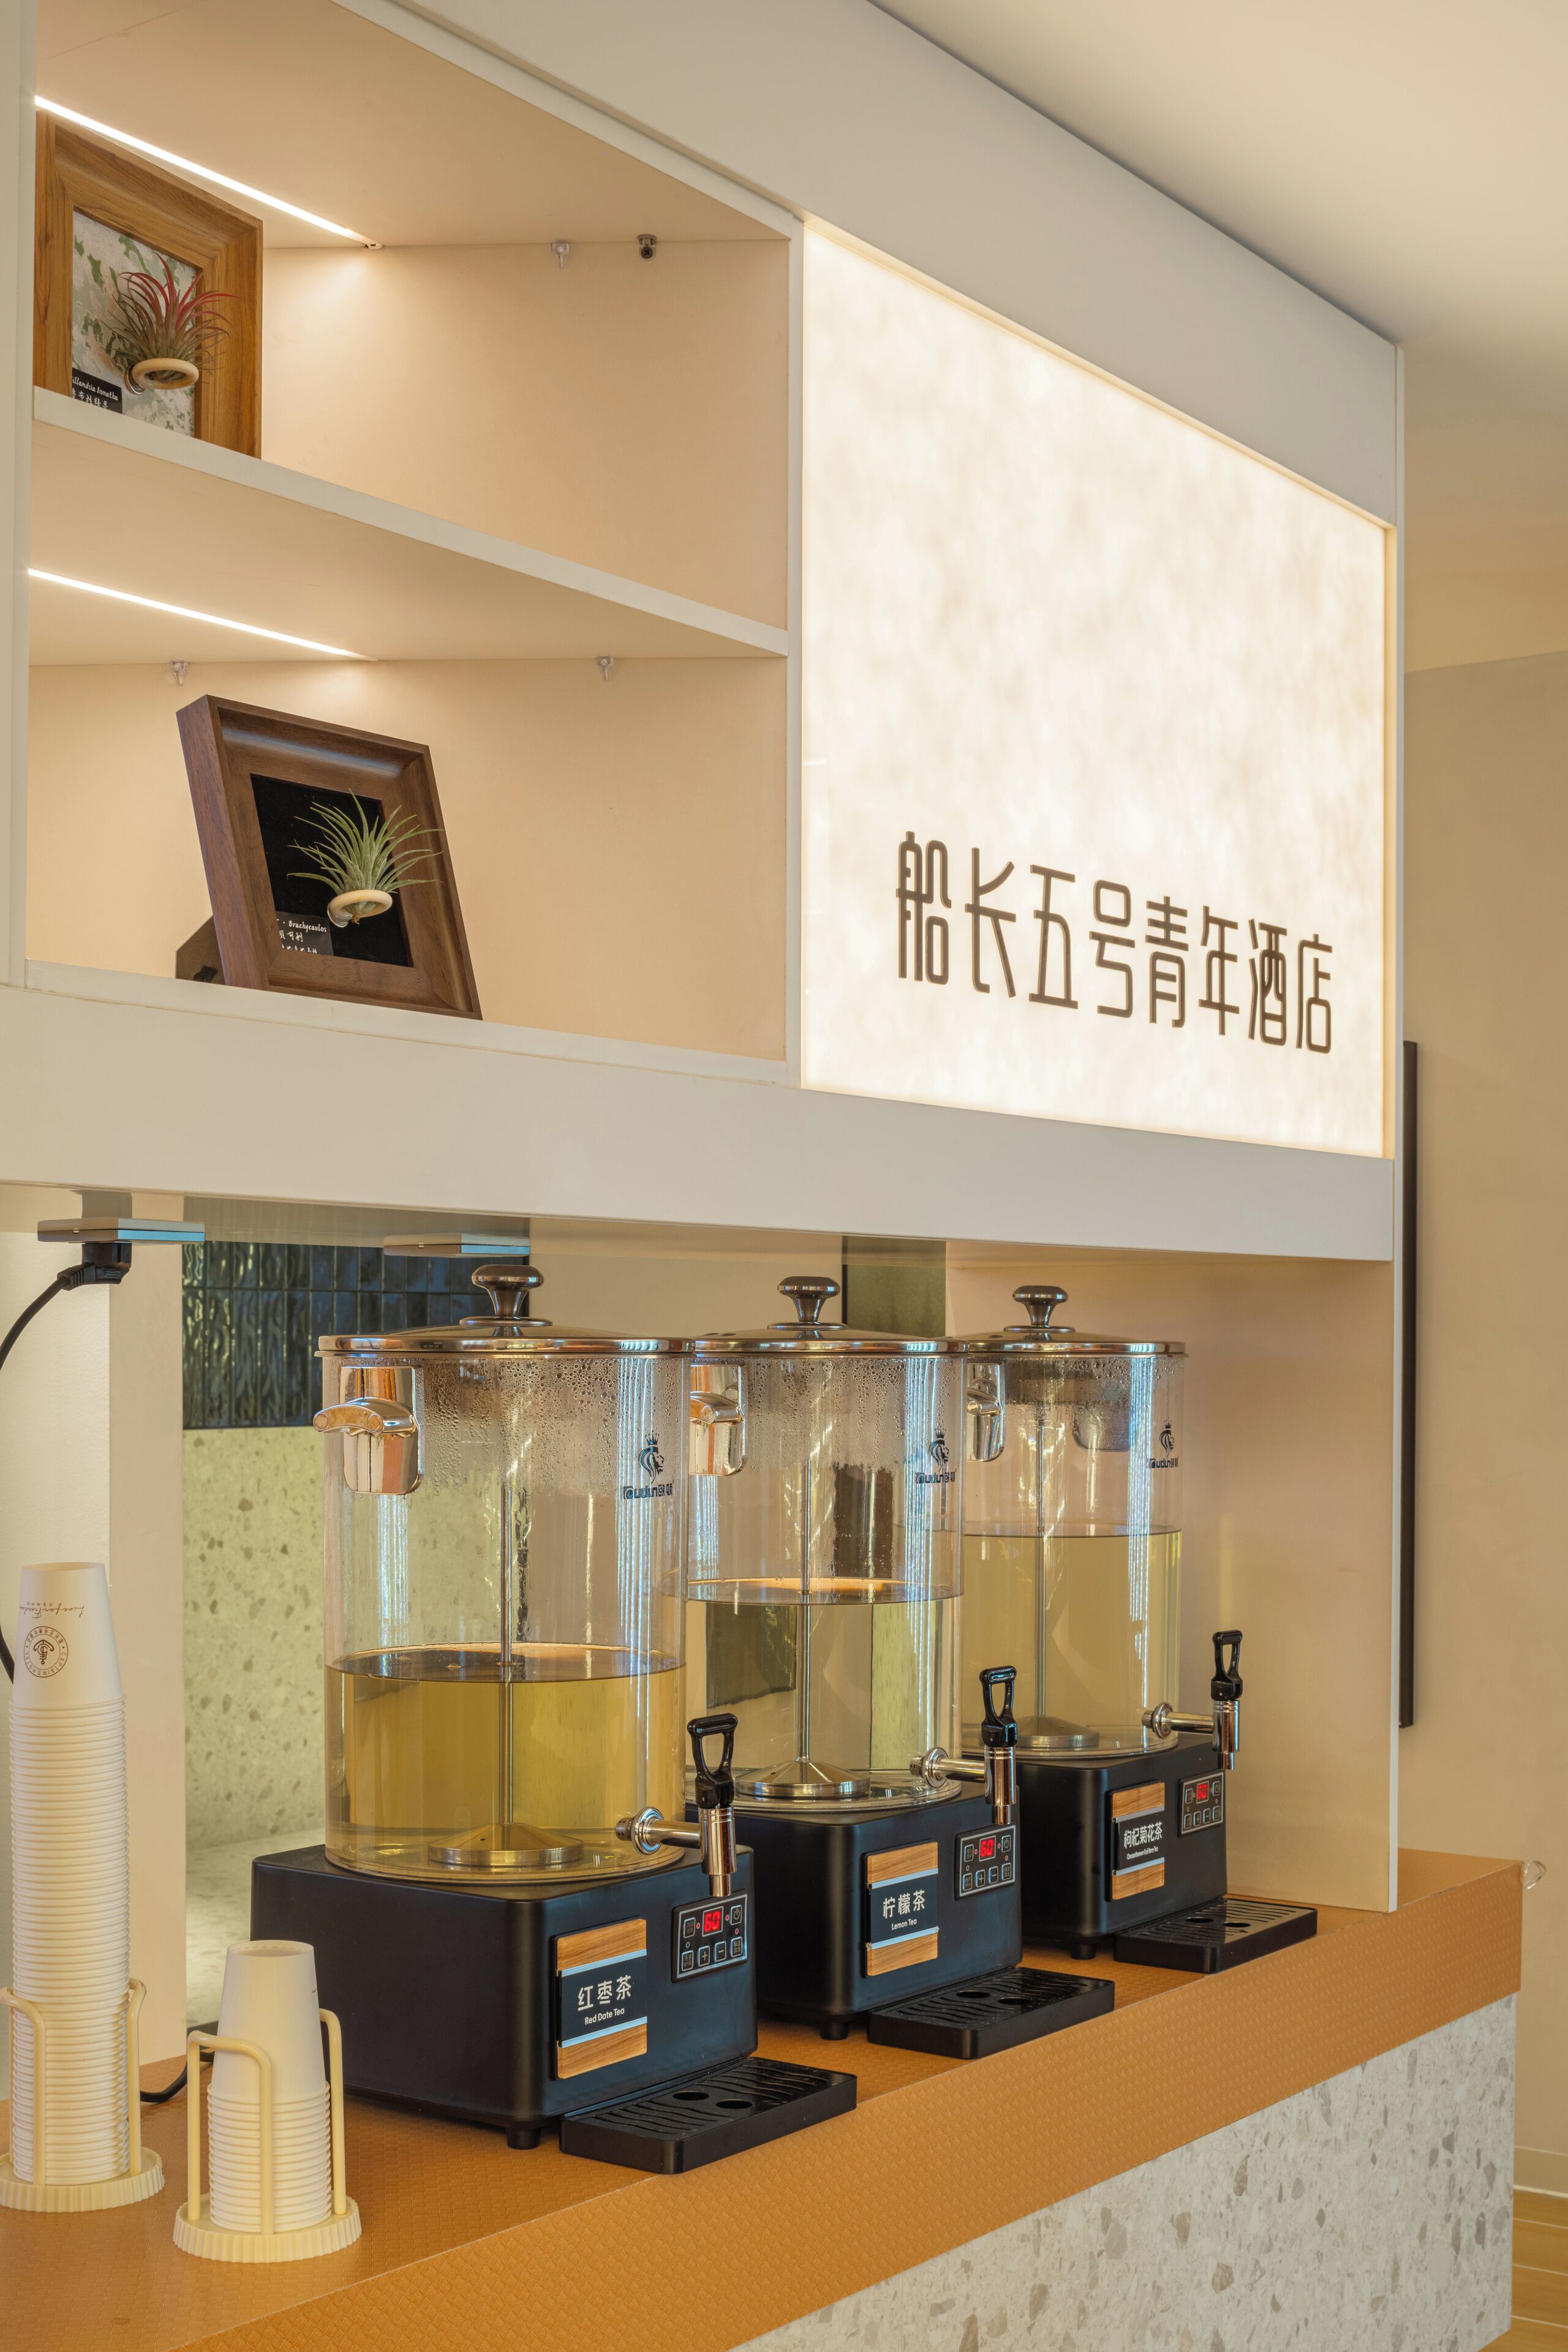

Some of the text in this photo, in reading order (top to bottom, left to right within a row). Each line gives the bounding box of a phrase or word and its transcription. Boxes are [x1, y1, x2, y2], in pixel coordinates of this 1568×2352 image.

[72, 376, 96, 393] illandsia
[895, 831, 1333, 1054] 船长五号青年酒店
[1123, 1821, 1163, 1849] 枸杞菊花茶
[981, 1839, 994, 1857] 60
[883, 1889, 925, 1919] 柠檬茶
[704, 1911, 721, 1932] 60
[891, 1921, 908, 1931] Lemon
[578, 1974, 631, 2011] 红枣茶
[584, 2008, 625, 2025] Red Date Tea
